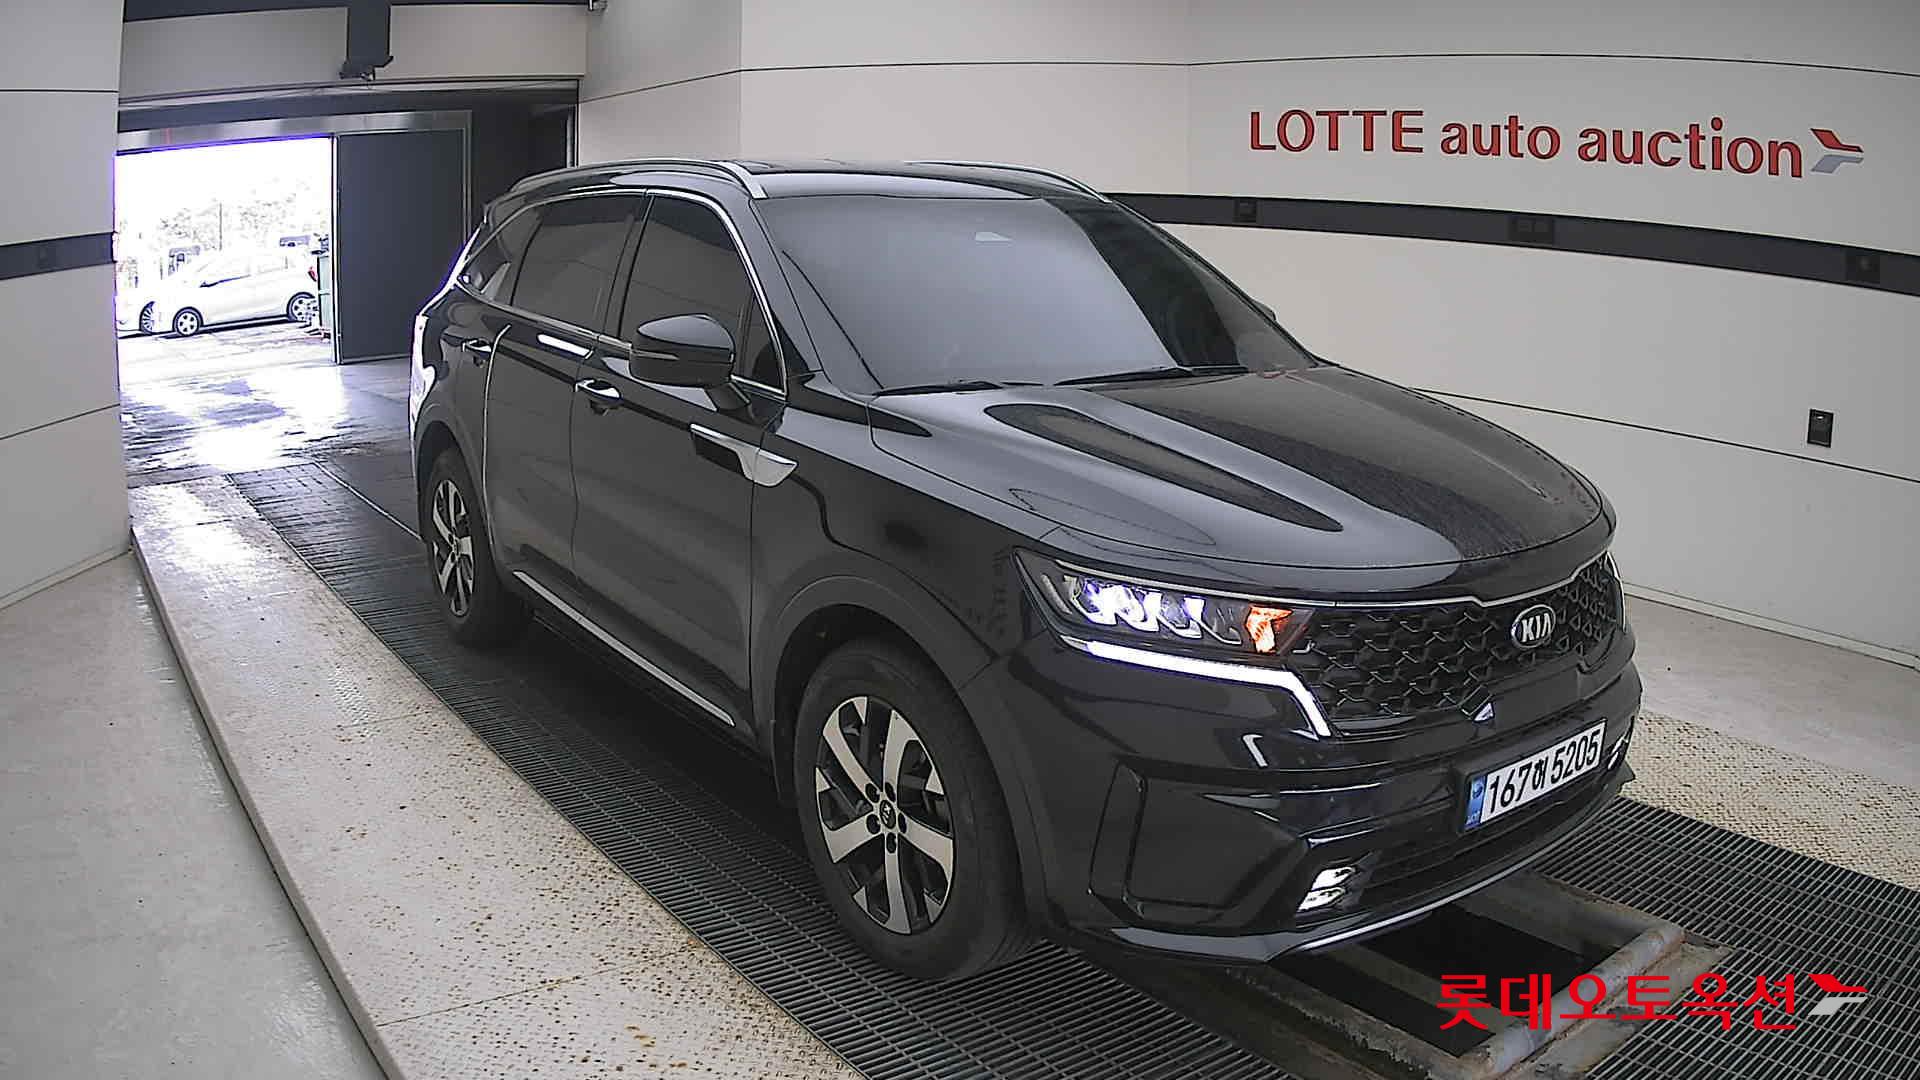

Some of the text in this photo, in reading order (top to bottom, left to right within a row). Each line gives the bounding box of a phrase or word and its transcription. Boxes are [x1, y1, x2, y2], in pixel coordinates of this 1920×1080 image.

[1250, 110, 1803, 178] LOTTE auto auction
[1521, 612, 1552, 643] KIA
[1550, 729, 1600, 785] 5205
